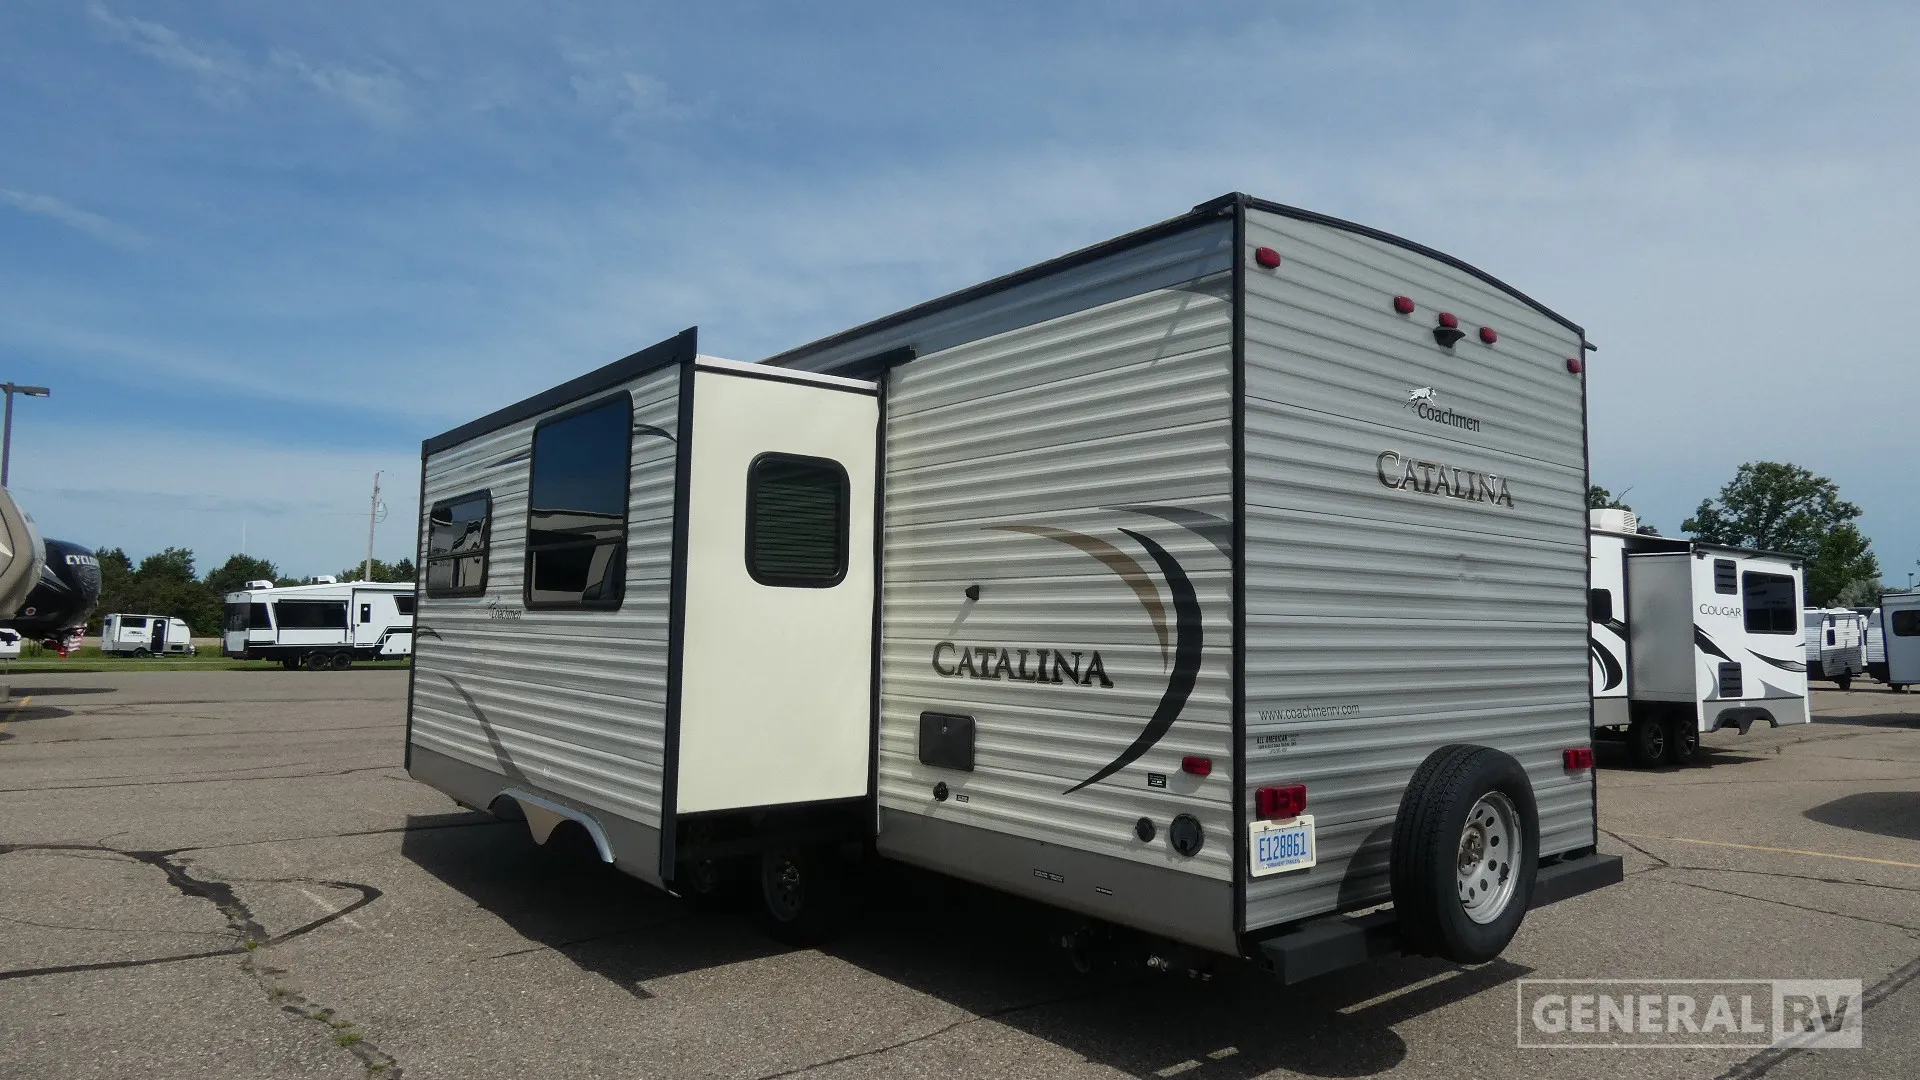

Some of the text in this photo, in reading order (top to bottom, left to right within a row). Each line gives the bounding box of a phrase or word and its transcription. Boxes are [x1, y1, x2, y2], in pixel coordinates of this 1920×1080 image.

[1418, 402, 1480, 432] Coachmen
[1376, 450, 1515, 509] CATALINA
[491, 605, 521, 620] Coachmen
[1700, 603, 1741, 616] COUGAR
[932, 641, 1114, 688] CATALINA
[1259, 704, 1360, 721] www.coachmenrv.com
[1259, 832, 1306, 862] E128861
